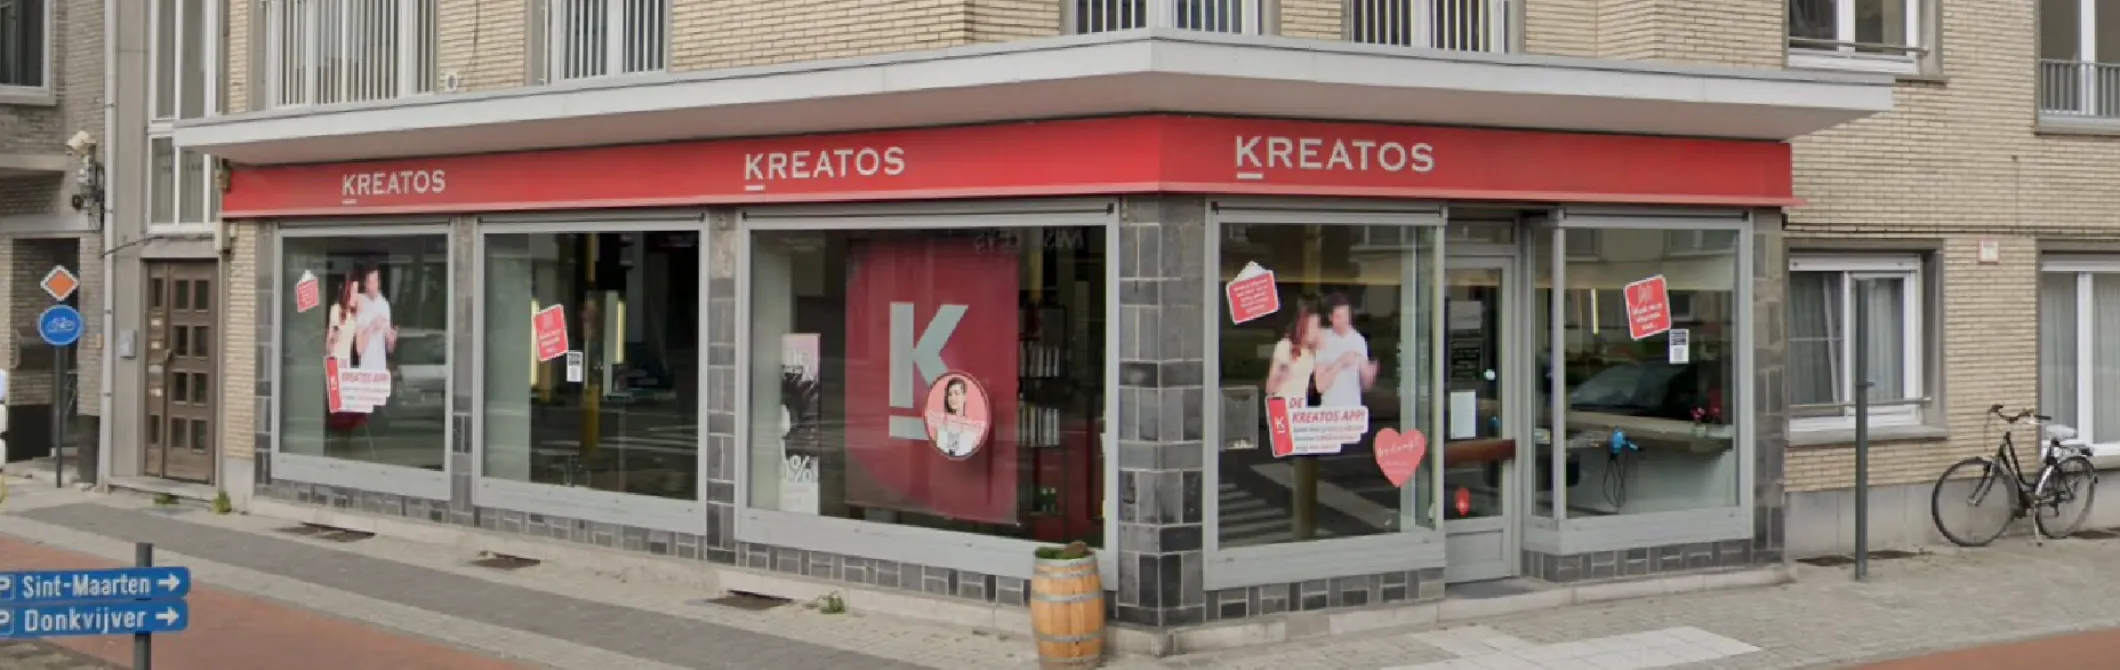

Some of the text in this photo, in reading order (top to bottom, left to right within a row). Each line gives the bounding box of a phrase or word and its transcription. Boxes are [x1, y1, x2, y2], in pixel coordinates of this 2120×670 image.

[745, 147, 905, 182] KREATOS
[1235, 136, 1434, 173] KREATOS
[342, 170, 445, 197] KREATOS
[889, 302, 969, 409] K
[1292, 411, 1340, 424] KREATOS
[22, 573, 150, 599] Sint-Maarten
[24, 606, 148, 634] Donkvijver
